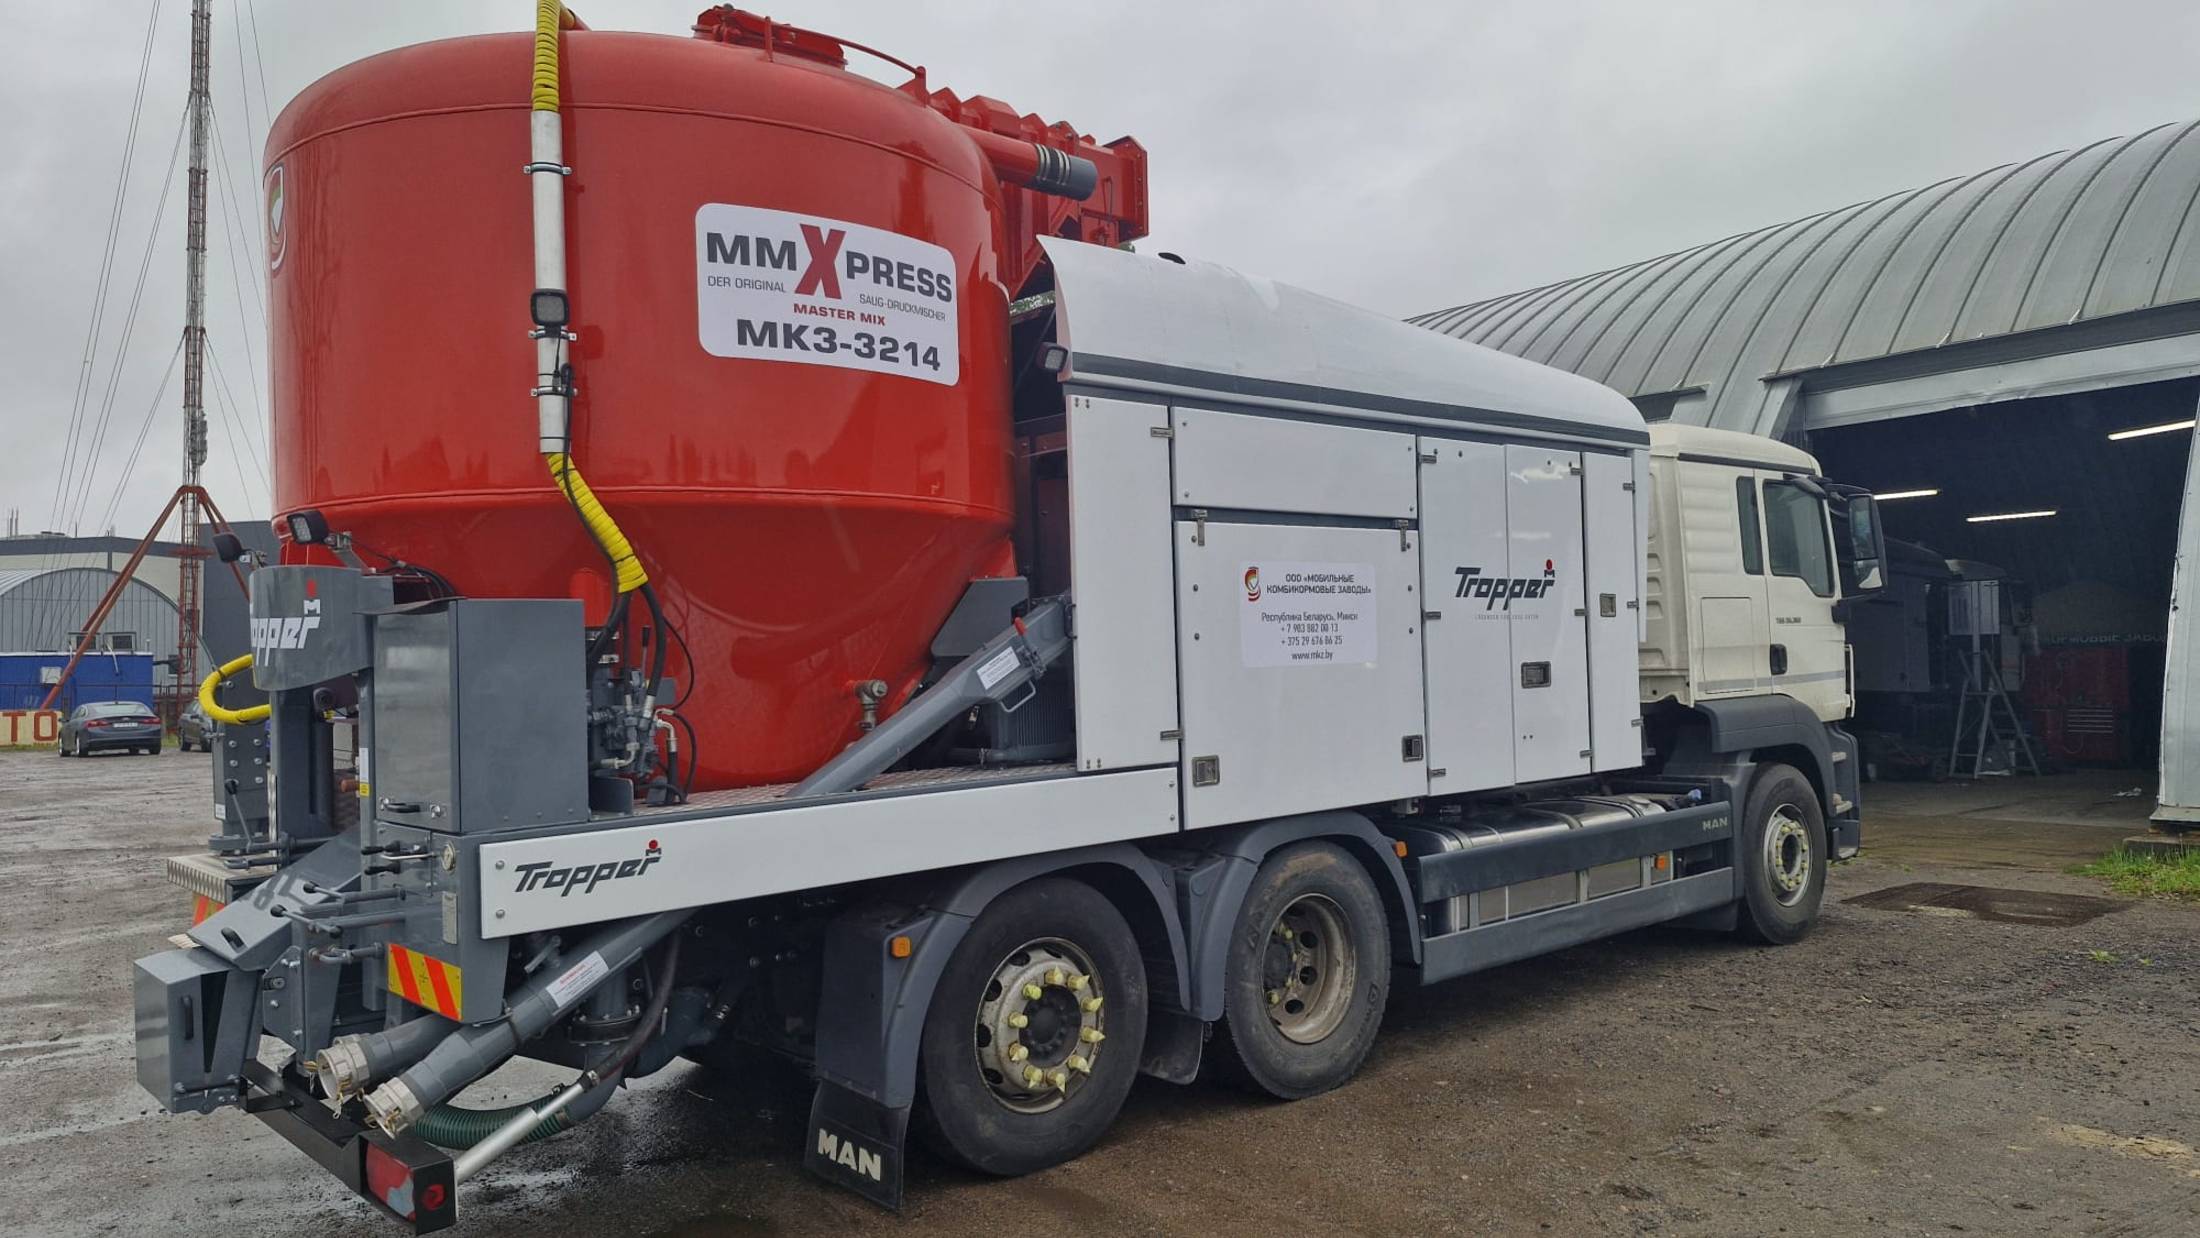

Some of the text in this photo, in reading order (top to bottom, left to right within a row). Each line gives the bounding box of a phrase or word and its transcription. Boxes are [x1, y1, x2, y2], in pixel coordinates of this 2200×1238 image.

[707, 275, 786, 293] DER ORIGINAL
[793, 302, 886, 327] MASTER MIX
[859, 293, 946, 321] SAUG-DRUCKMISCHER
[736, 318, 941, 371] MK3-3214
[1266, 585, 1336, 594] КОМБИКОРМОВЫЕ
[1261, 612, 1302, 623] Республика
[1337, 611, 1359, 621] Минск
[1287, 636, 1300, 646] 375
[1301, 636, 1310, 646] 29
[1334, 635, 1343, 645] 25
[1291, 649, 1334, 662] www.mkz.by
[1702, 816, 1729, 832] MAN
[817, 1127, 881, 1182] MAN
